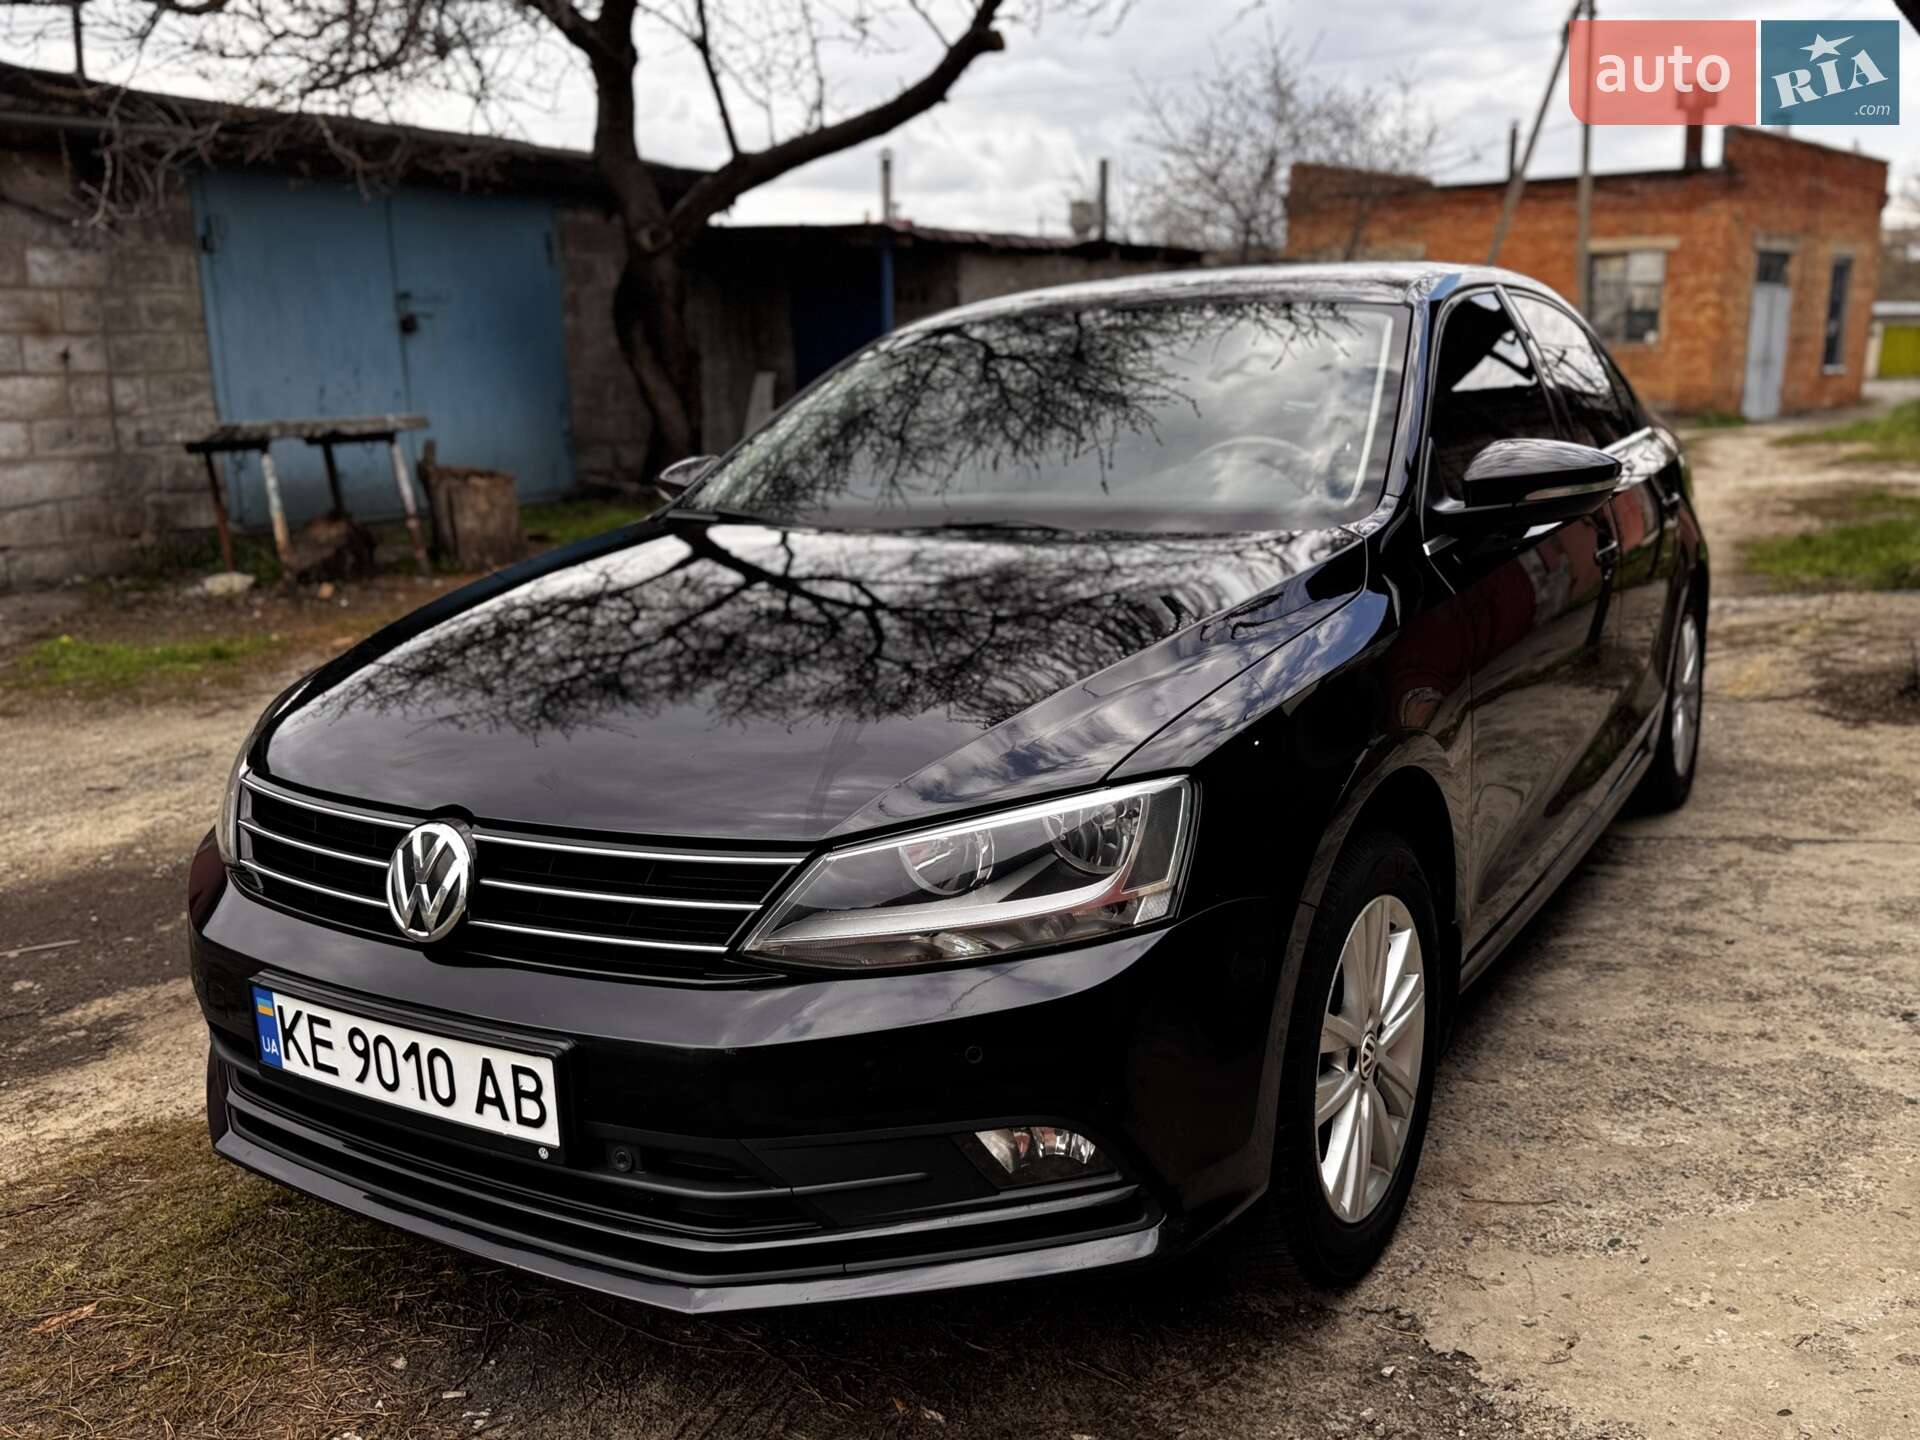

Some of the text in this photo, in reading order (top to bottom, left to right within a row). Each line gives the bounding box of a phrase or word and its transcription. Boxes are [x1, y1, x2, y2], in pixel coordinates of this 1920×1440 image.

[262, 1035, 279, 1056] UA
[277, 1005, 547, 1129] KE 9010 AB
